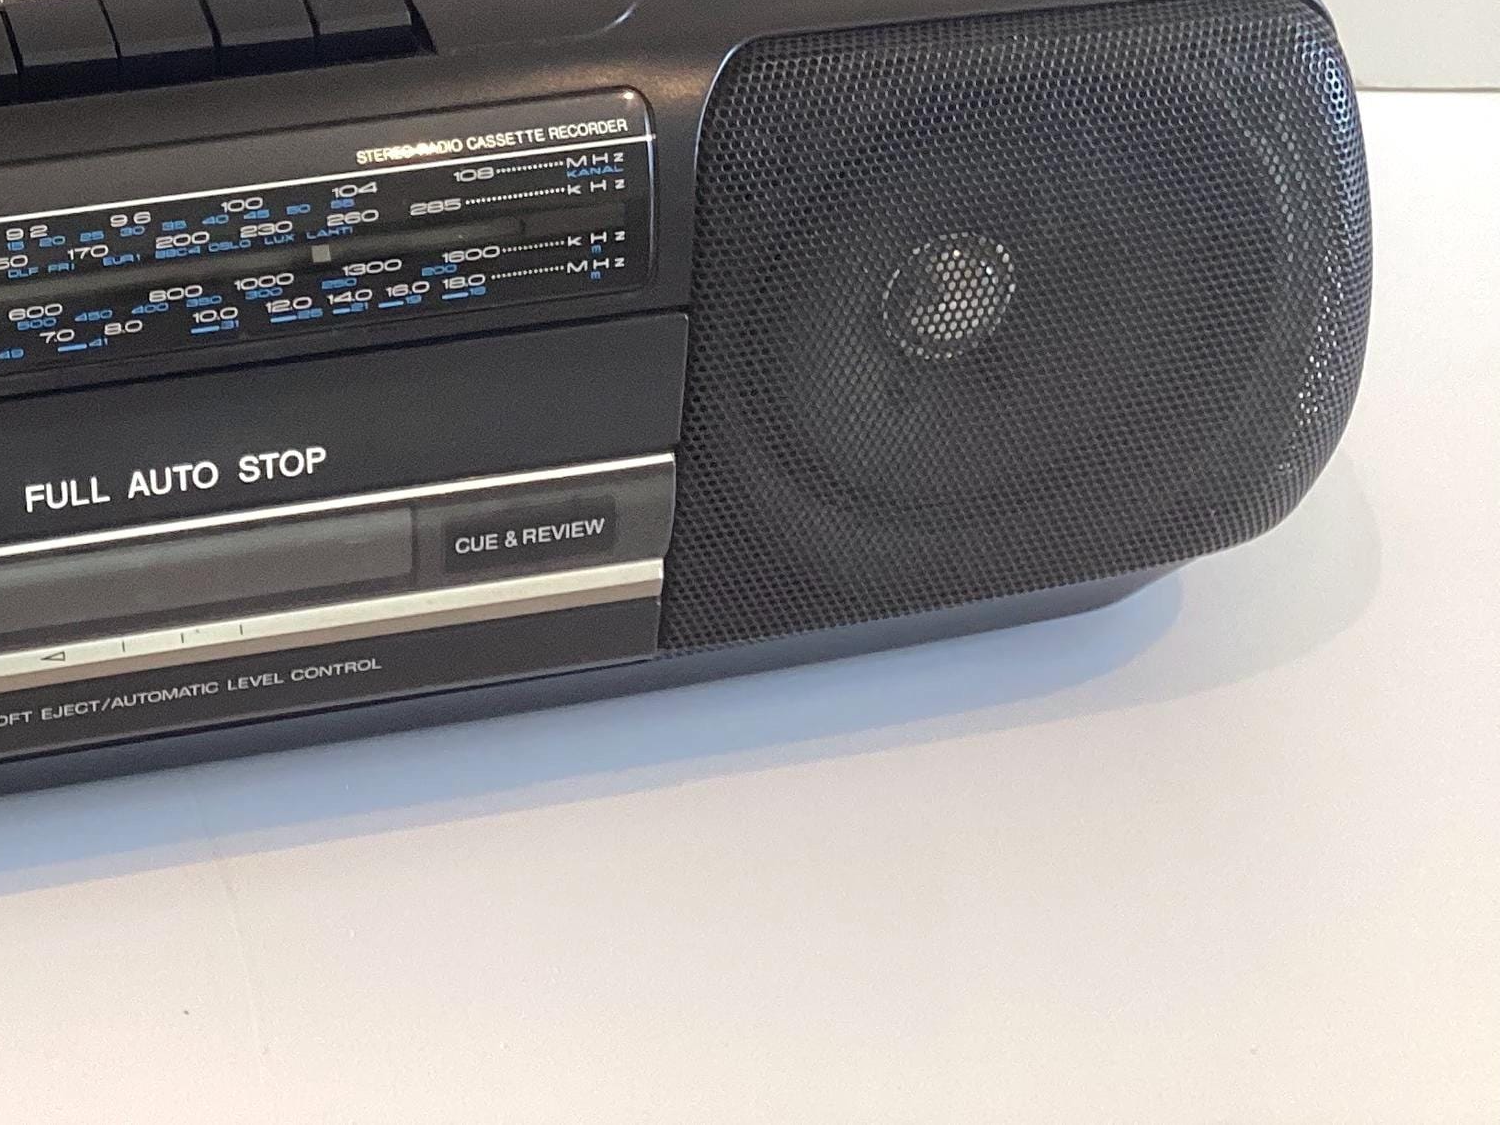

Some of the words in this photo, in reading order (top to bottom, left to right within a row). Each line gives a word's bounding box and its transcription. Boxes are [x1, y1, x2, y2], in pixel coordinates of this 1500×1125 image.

[465, 127, 547, 152] CASSETTE
[547, 118, 629, 142] RECORDER
[220, 197, 264, 213] 100
[331, 181, 379, 199] 104
[452, 166, 496, 184] 108
[566, 164, 625, 179] KANAL
[67, 244, 109, 261] 170
[155, 230, 211, 250] 200
[239, 220, 293, 239] 230
[326, 208, 380, 227] 260
[410, 198, 462, 216] 285
[263, 233, 296, 246] LUX
[8, 303, 63, 321] 600
[233, 272, 295, 292] 1000
[342, 258, 403, 277] 1300
[441, 245, 501, 264] 1600
[25, 476, 112, 514] FULL
[127, 461, 220, 500] AUTO
[238, 446, 327, 484] STOP
[454, 533, 500, 554] CUE
[503, 529, 519, 549] &
[521, 517, 606, 546] REVIEW
[41, 681, 220, 722] EJECT/AUTOMATIC
[227, 671, 285, 692] LEVEL
[290, 658, 383, 682] CONTROL
